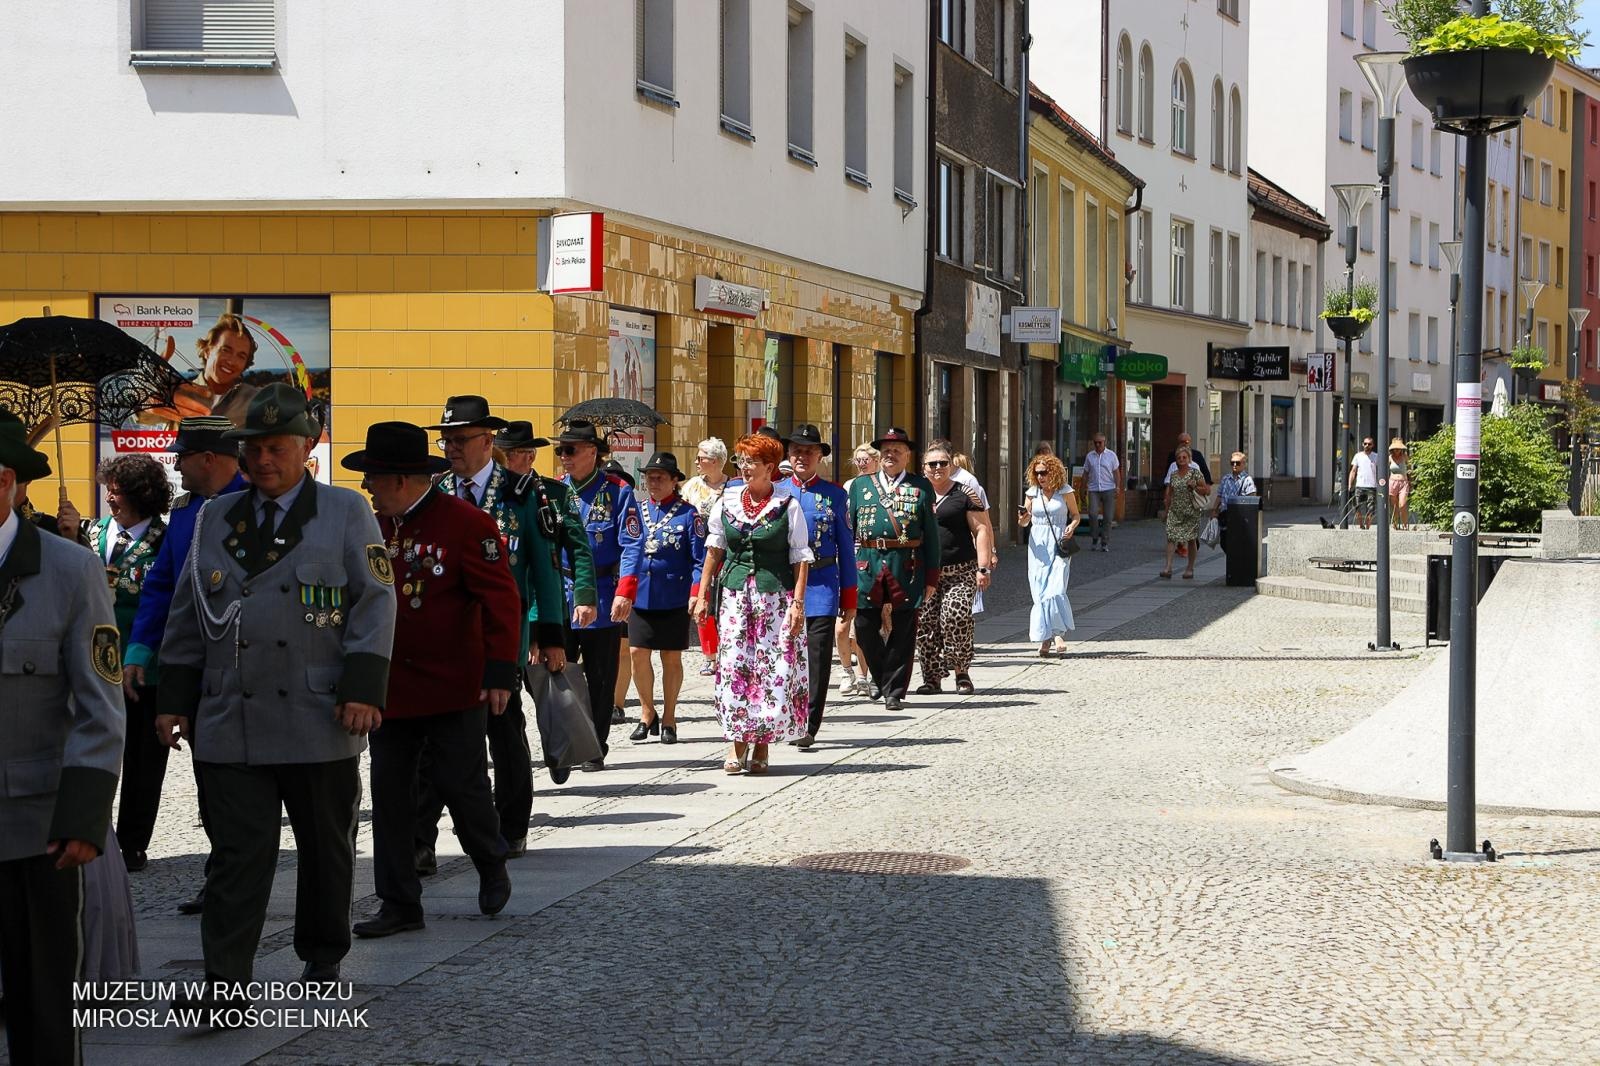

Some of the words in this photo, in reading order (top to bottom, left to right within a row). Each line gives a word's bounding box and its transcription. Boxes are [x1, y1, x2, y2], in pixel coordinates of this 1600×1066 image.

[137, 305, 162, 316] Bank
[163, 305, 193, 316] Pekao
[1252, 352, 1283, 364] Jubiler
[1119, 360, 1163, 372] żabka
